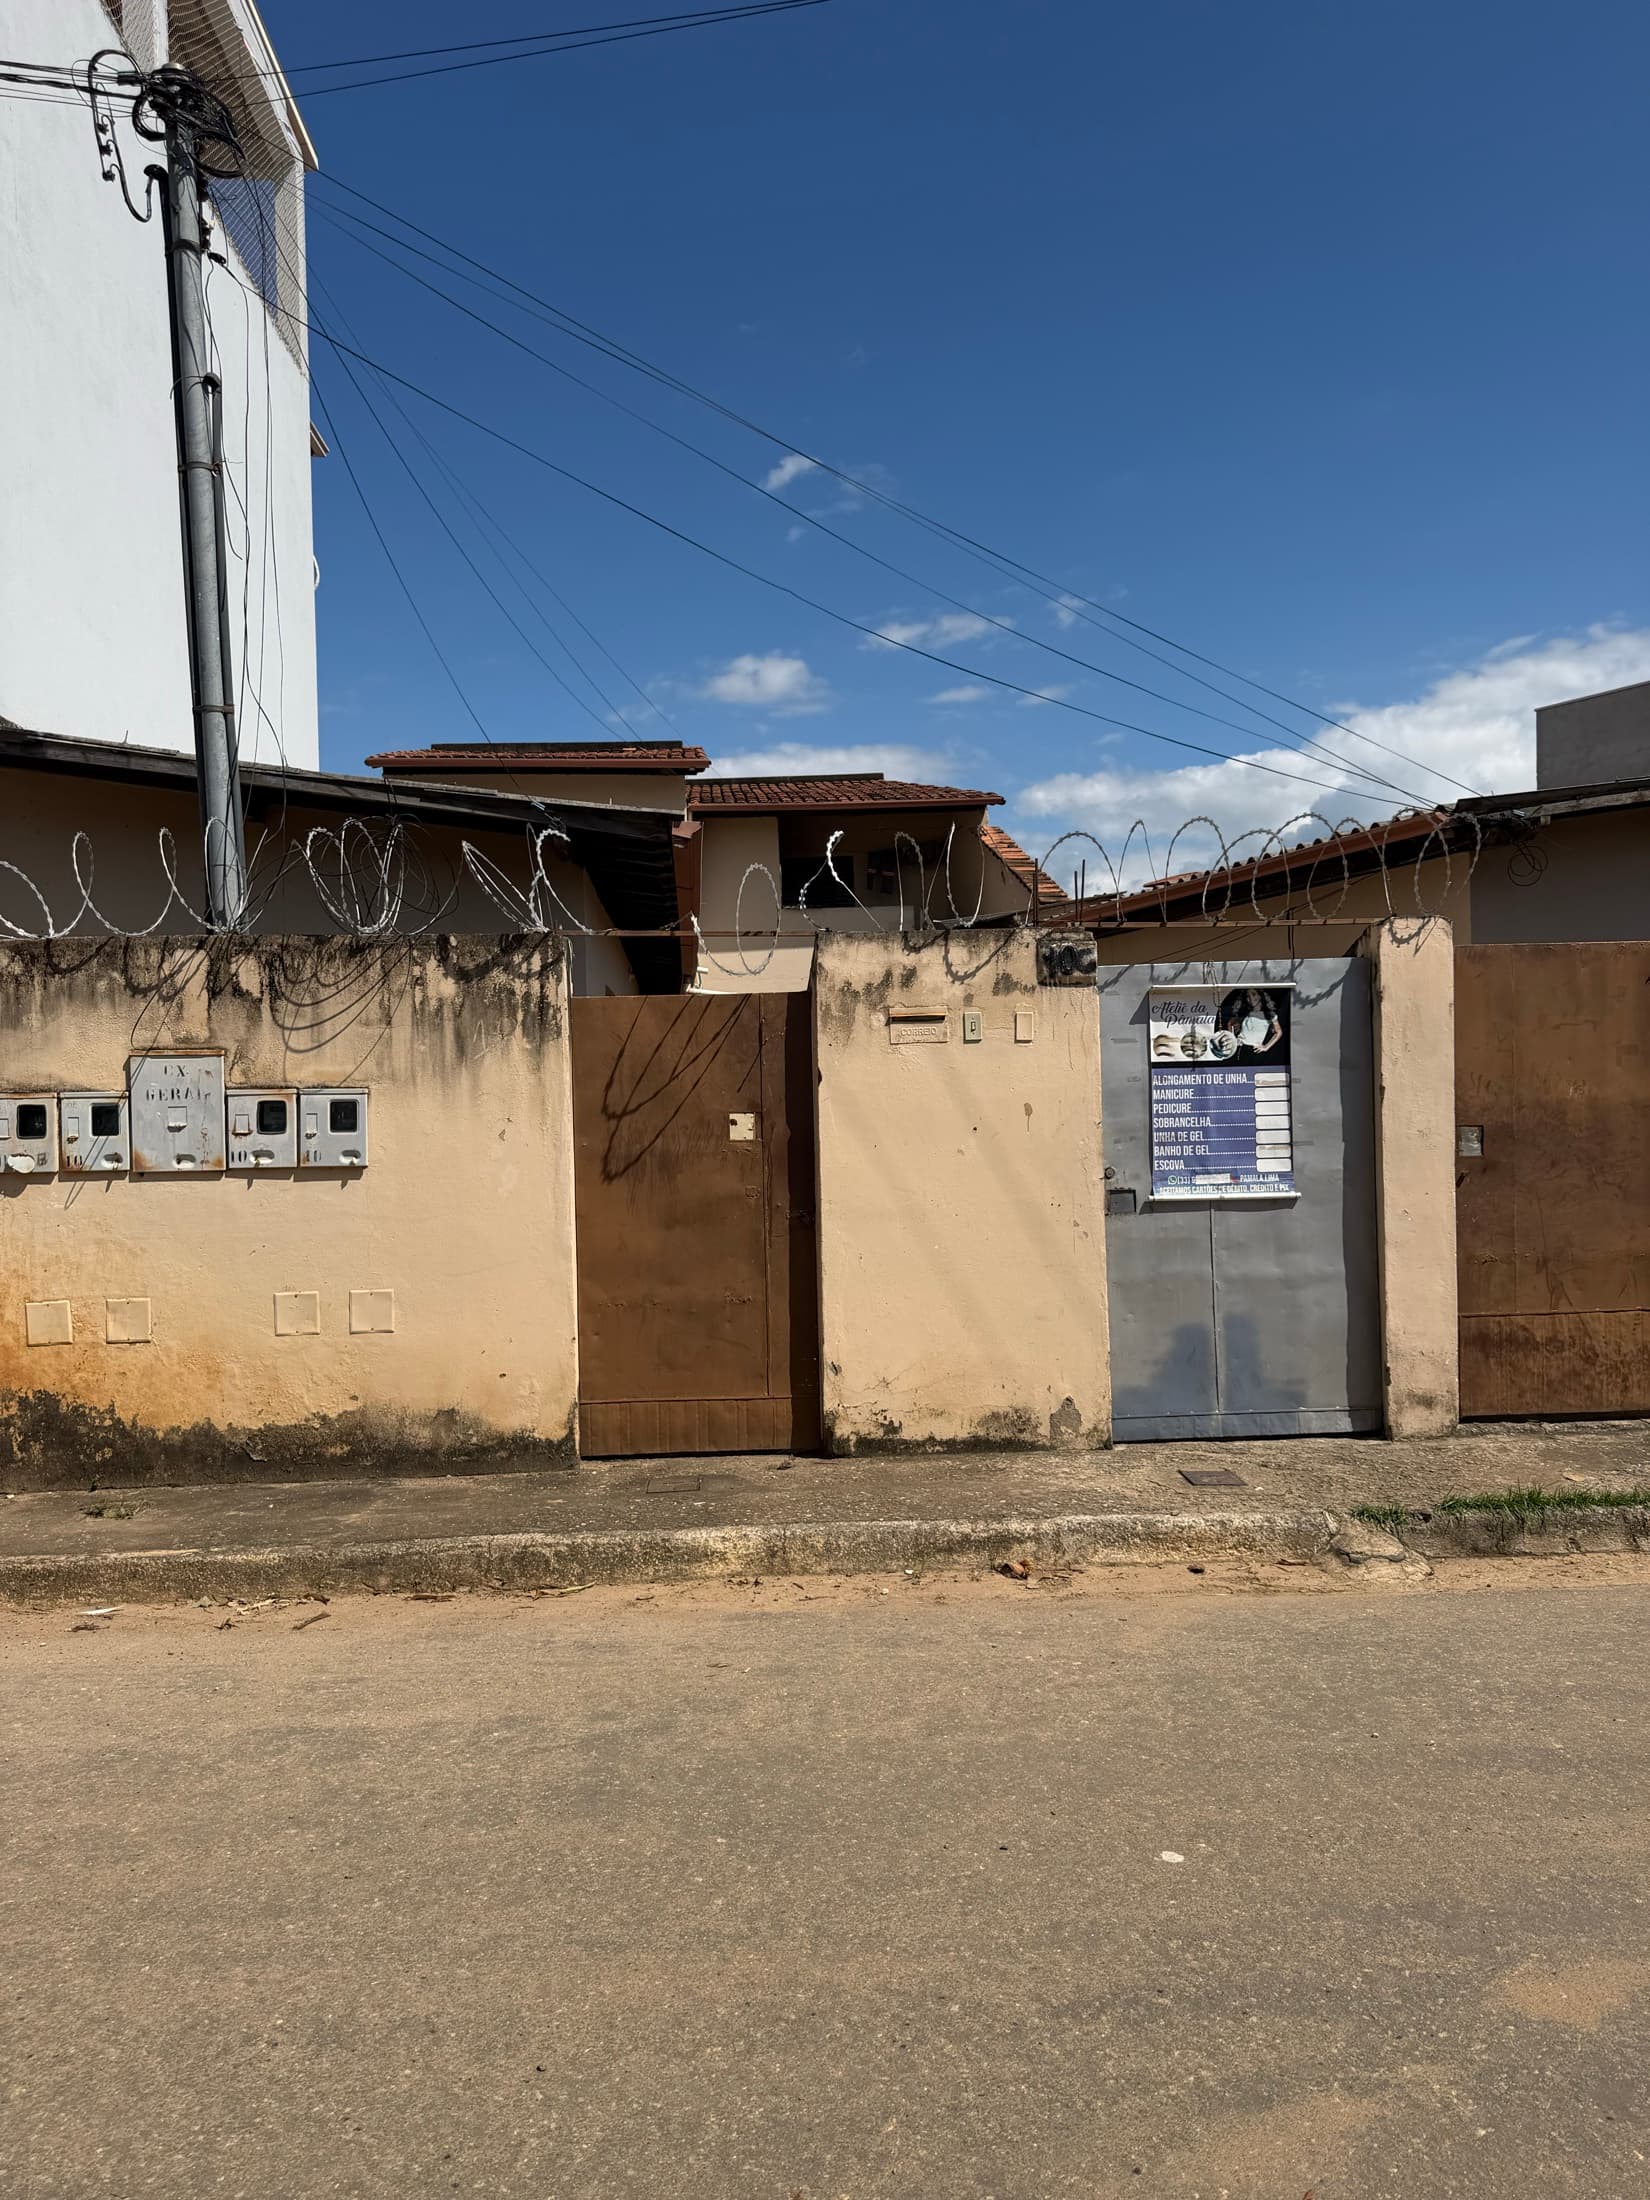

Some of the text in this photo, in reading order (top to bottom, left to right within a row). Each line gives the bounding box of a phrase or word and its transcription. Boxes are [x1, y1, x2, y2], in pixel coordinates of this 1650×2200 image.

[1190, 1001, 1206, 1013] da
[1153, 1073, 1247, 1086] ALONGAMENTO DE UNHA
[1153, 1089, 1194, 1100] MANICURE
[1153, 1103, 1192, 1114] PEDICURE
[1153, 1117, 1211, 1128] SOBRANCELHA
[1154, 1131, 1204, 1142] UNHA DE GEL
[1154, 1145, 1210, 1156] BANHO DE GEL
[1154, 1160, 1185, 1170] ESCOVA
